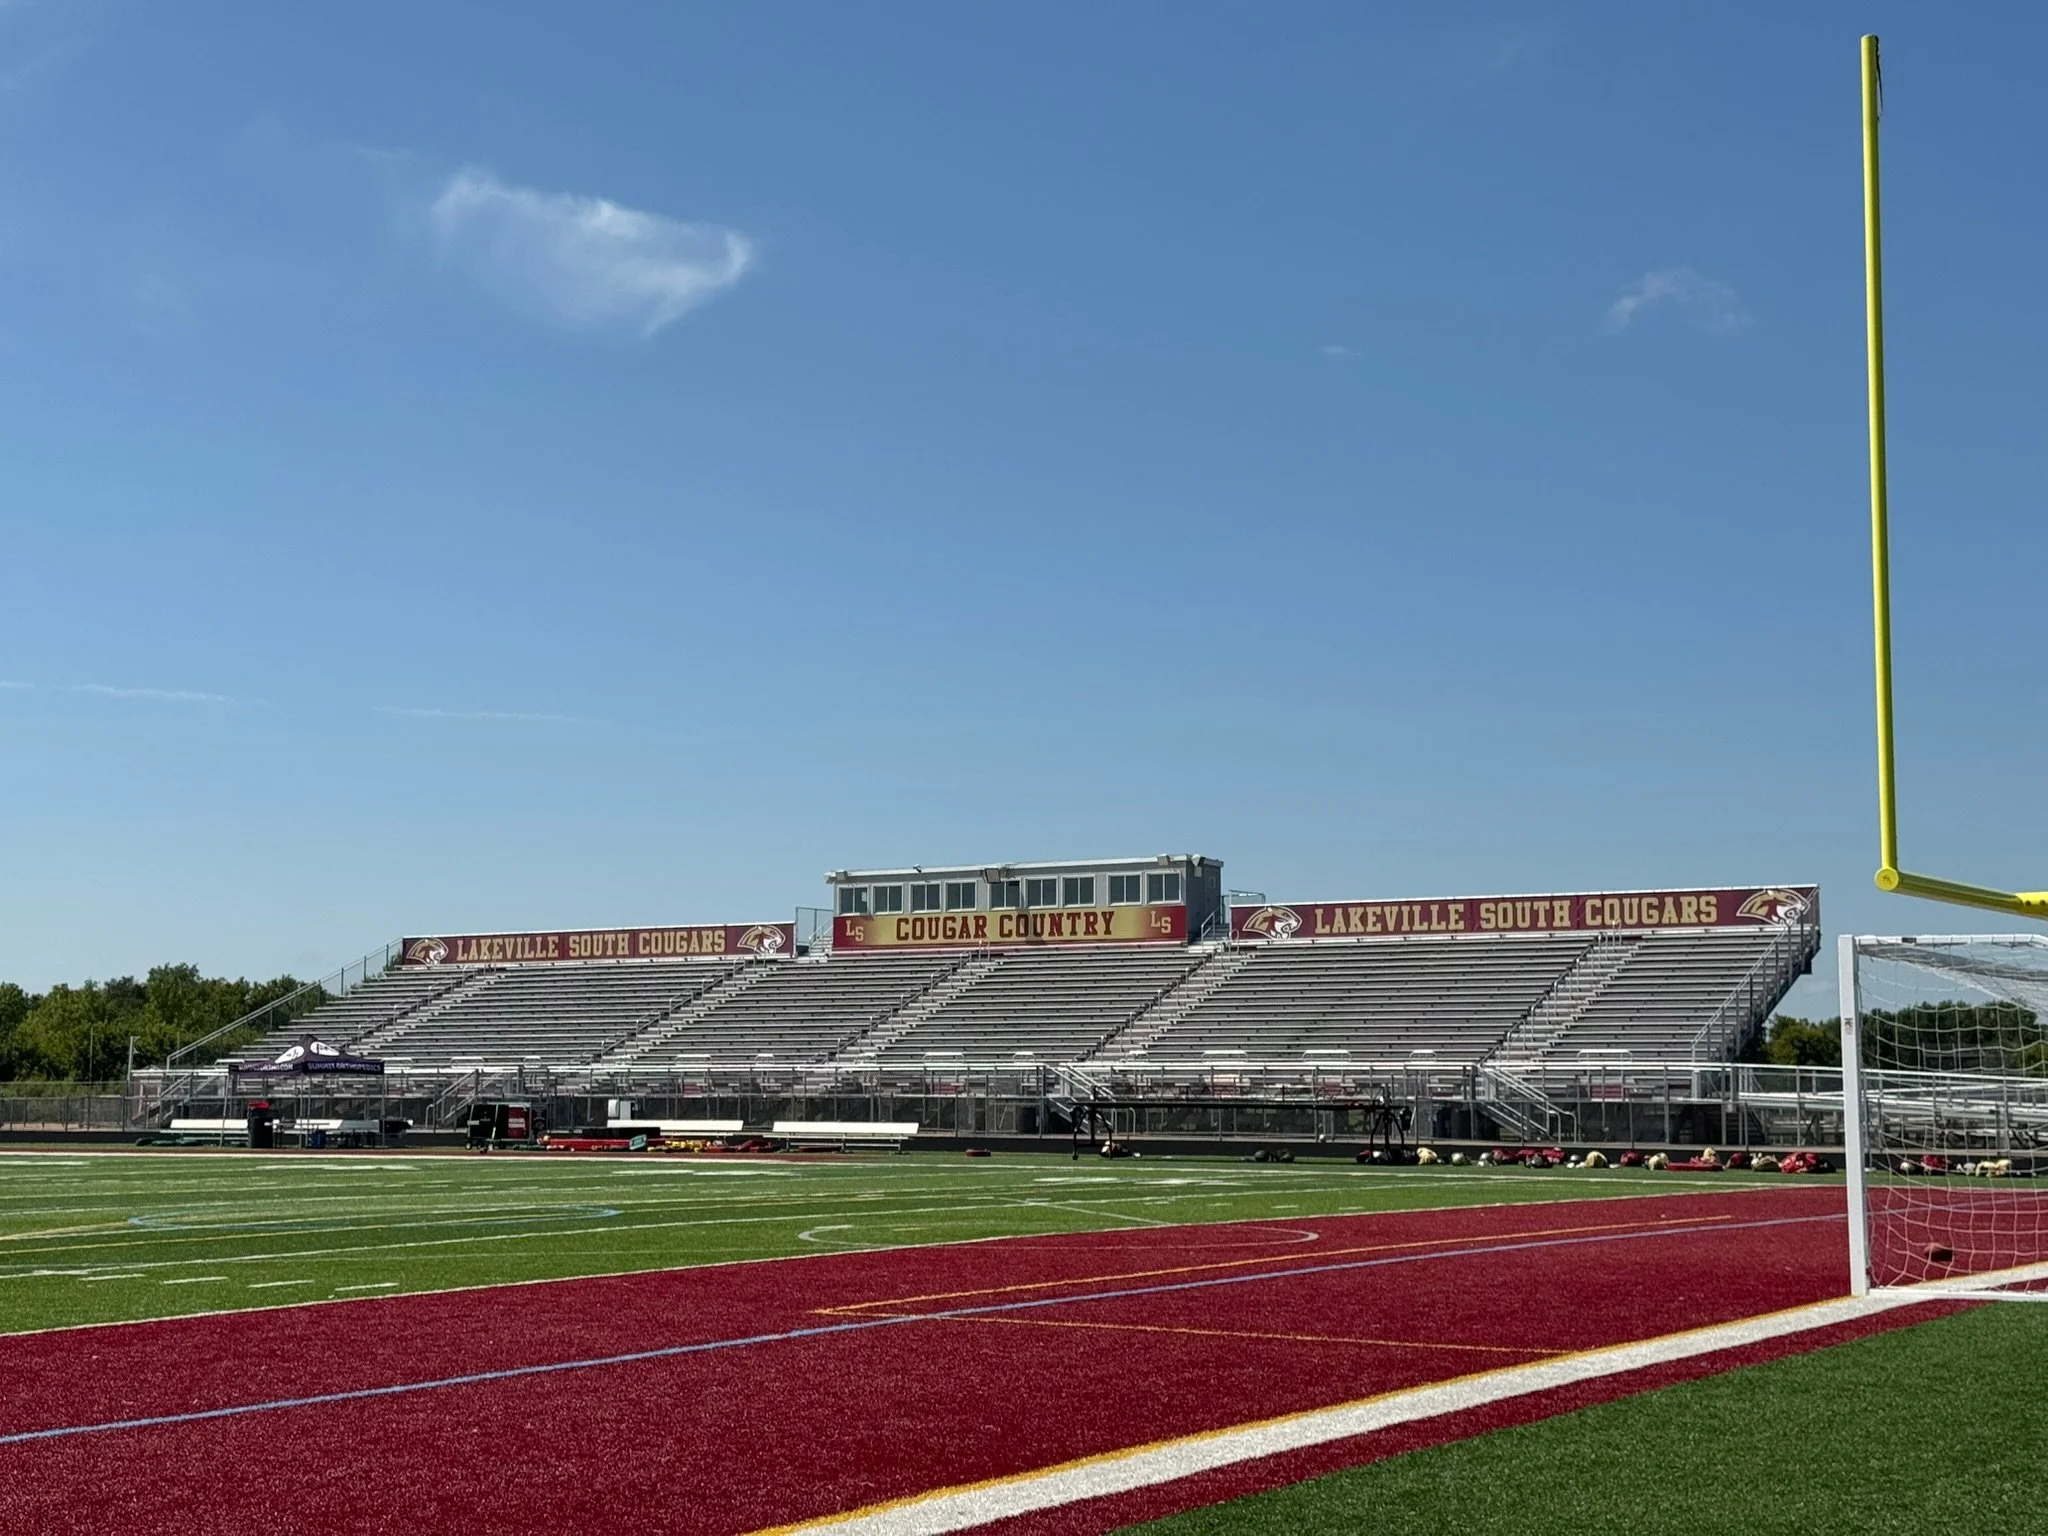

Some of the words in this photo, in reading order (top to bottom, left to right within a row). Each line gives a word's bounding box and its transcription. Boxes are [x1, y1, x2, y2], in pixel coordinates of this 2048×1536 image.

[896, 915, 988, 941] COUGAR
[998, 910, 1115, 938] COUNTRY
[1150, 910, 1171, 934] LS
[1314, 903, 1465, 934] LAKEVILLE
[1479, 900, 1571, 929] SOUTH
[1585, 895, 1717, 925] COUGARS
[456, 935, 559, 961] LAKEVILLE
[568, 933, 630, 957] SOUTH
[638, 929, 726, 954] COUGARS
[845, 919, 864, 942] LS
